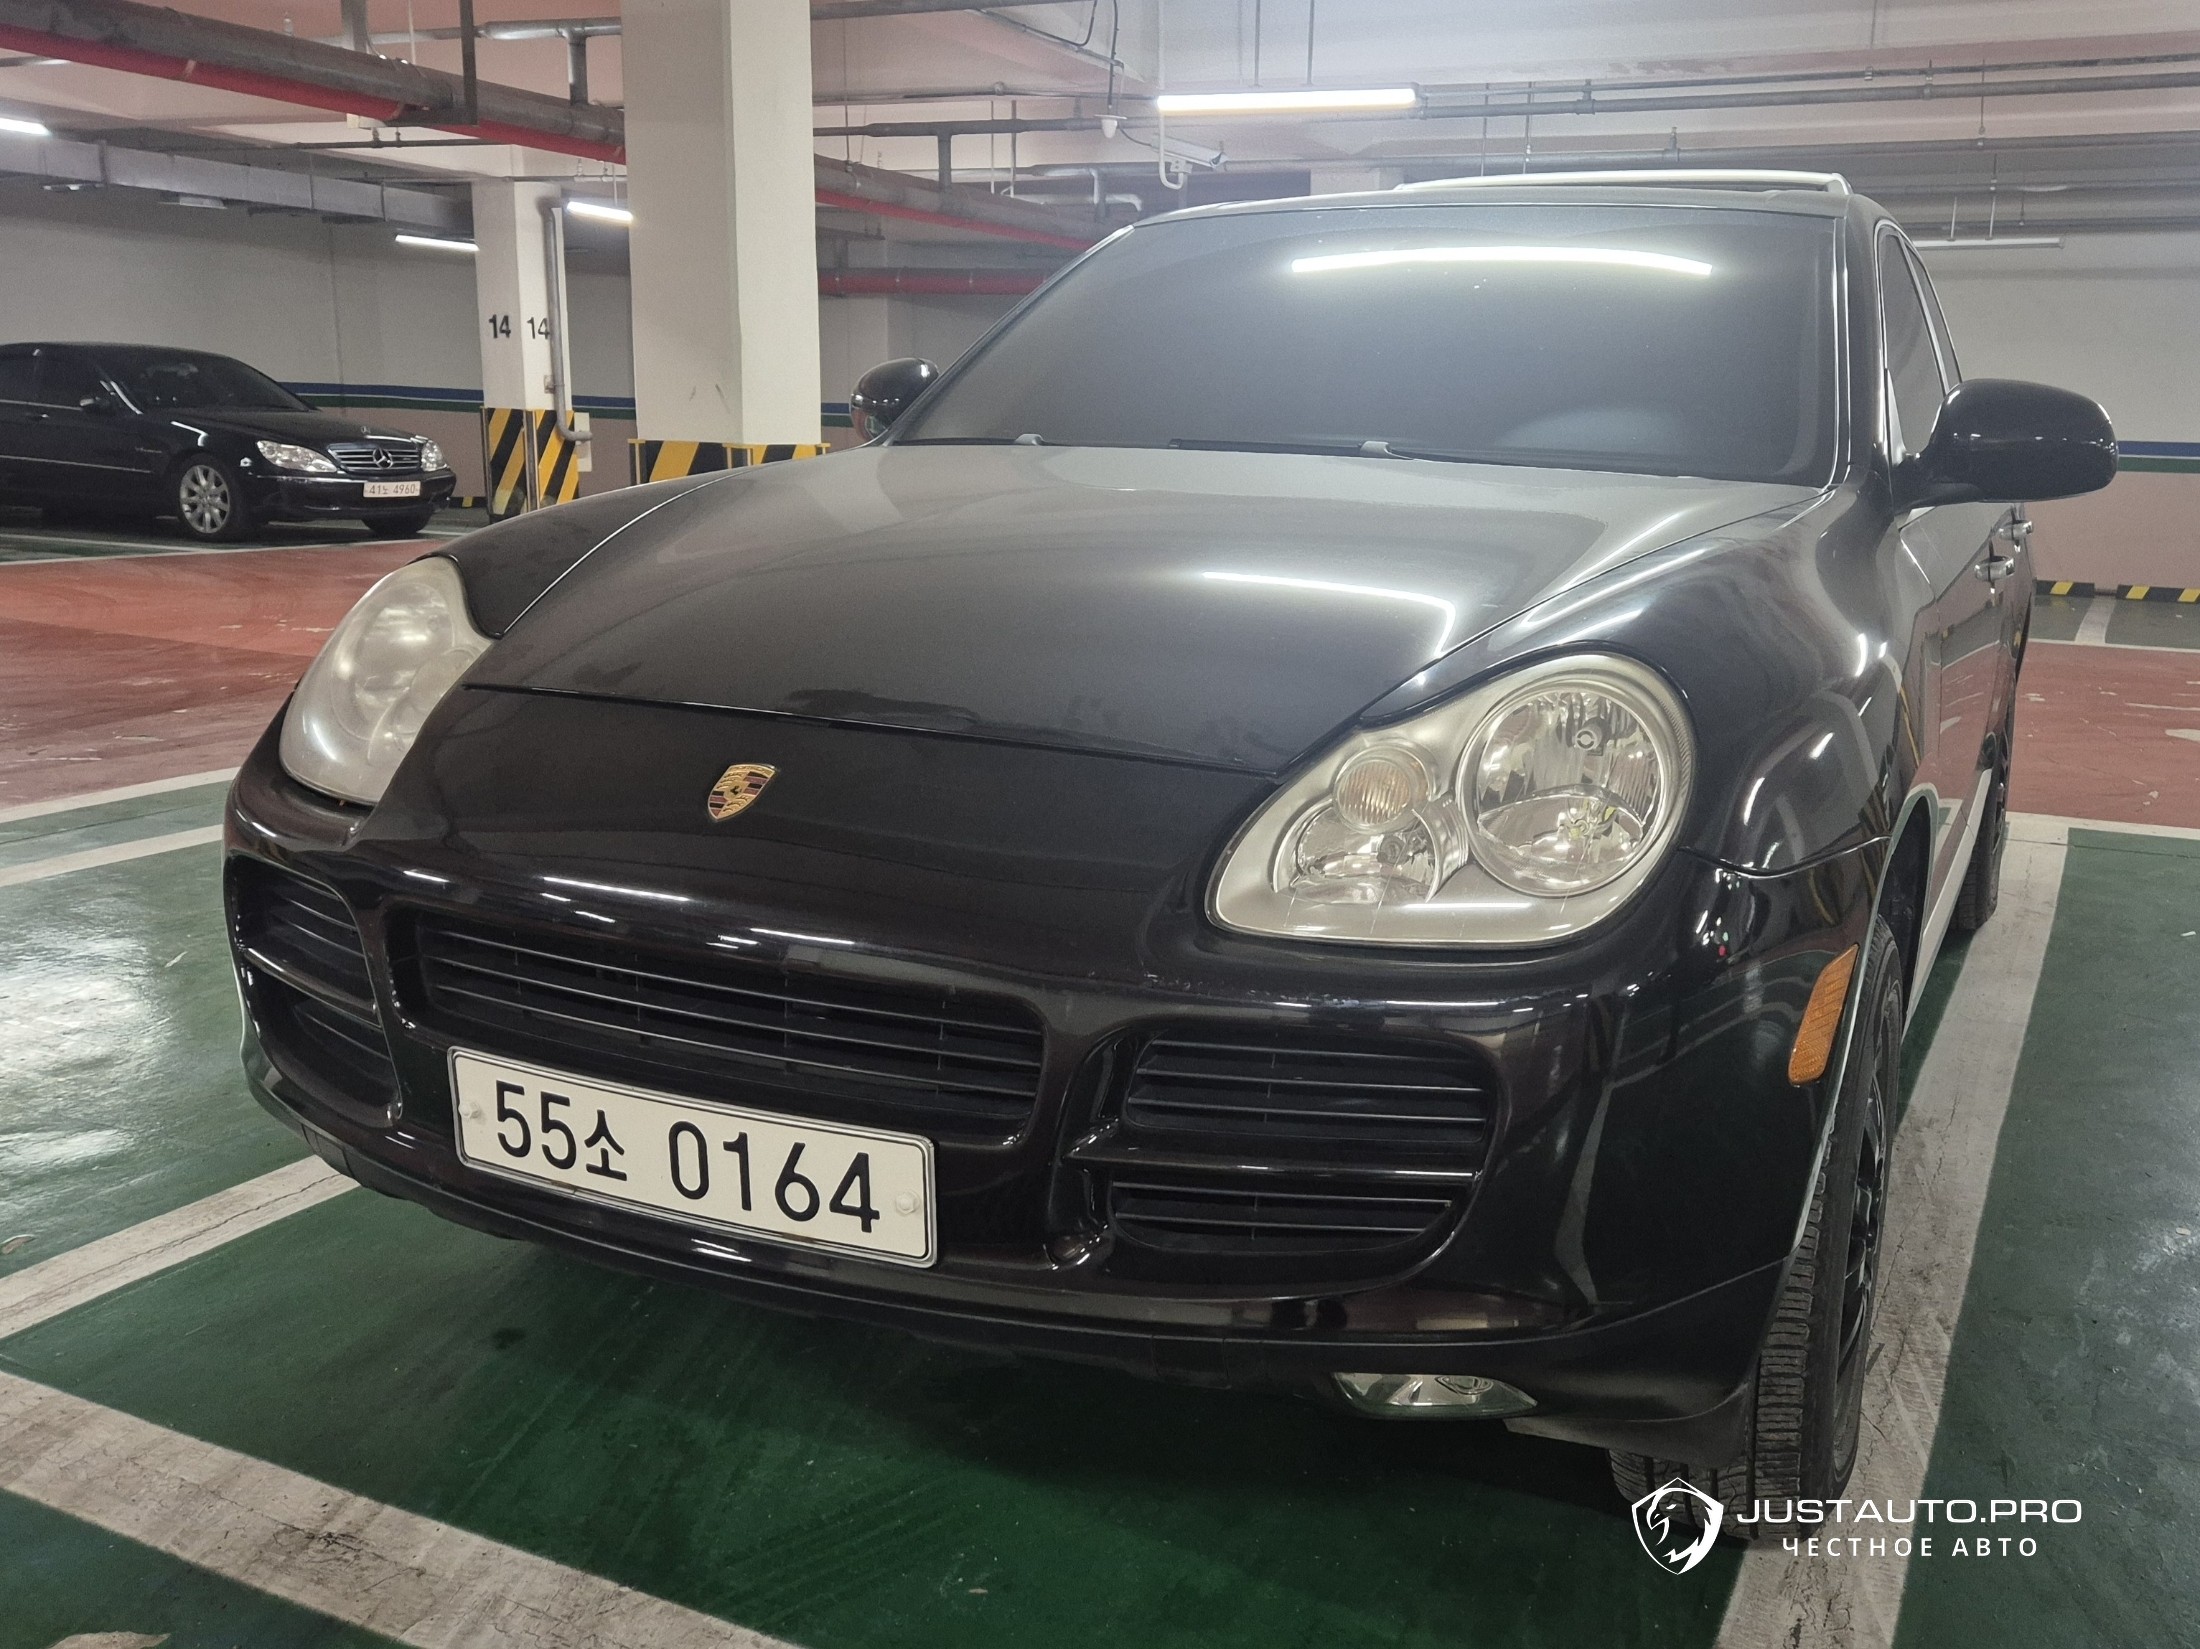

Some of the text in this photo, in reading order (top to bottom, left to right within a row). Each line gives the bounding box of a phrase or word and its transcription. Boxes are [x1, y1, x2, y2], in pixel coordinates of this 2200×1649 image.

[488, 314, 512, 339] 14
[526, 316, 550, 340] 14
[393, 483, 416, 495] 4960
[495, 1079, 881, 1234] 55소 0164
